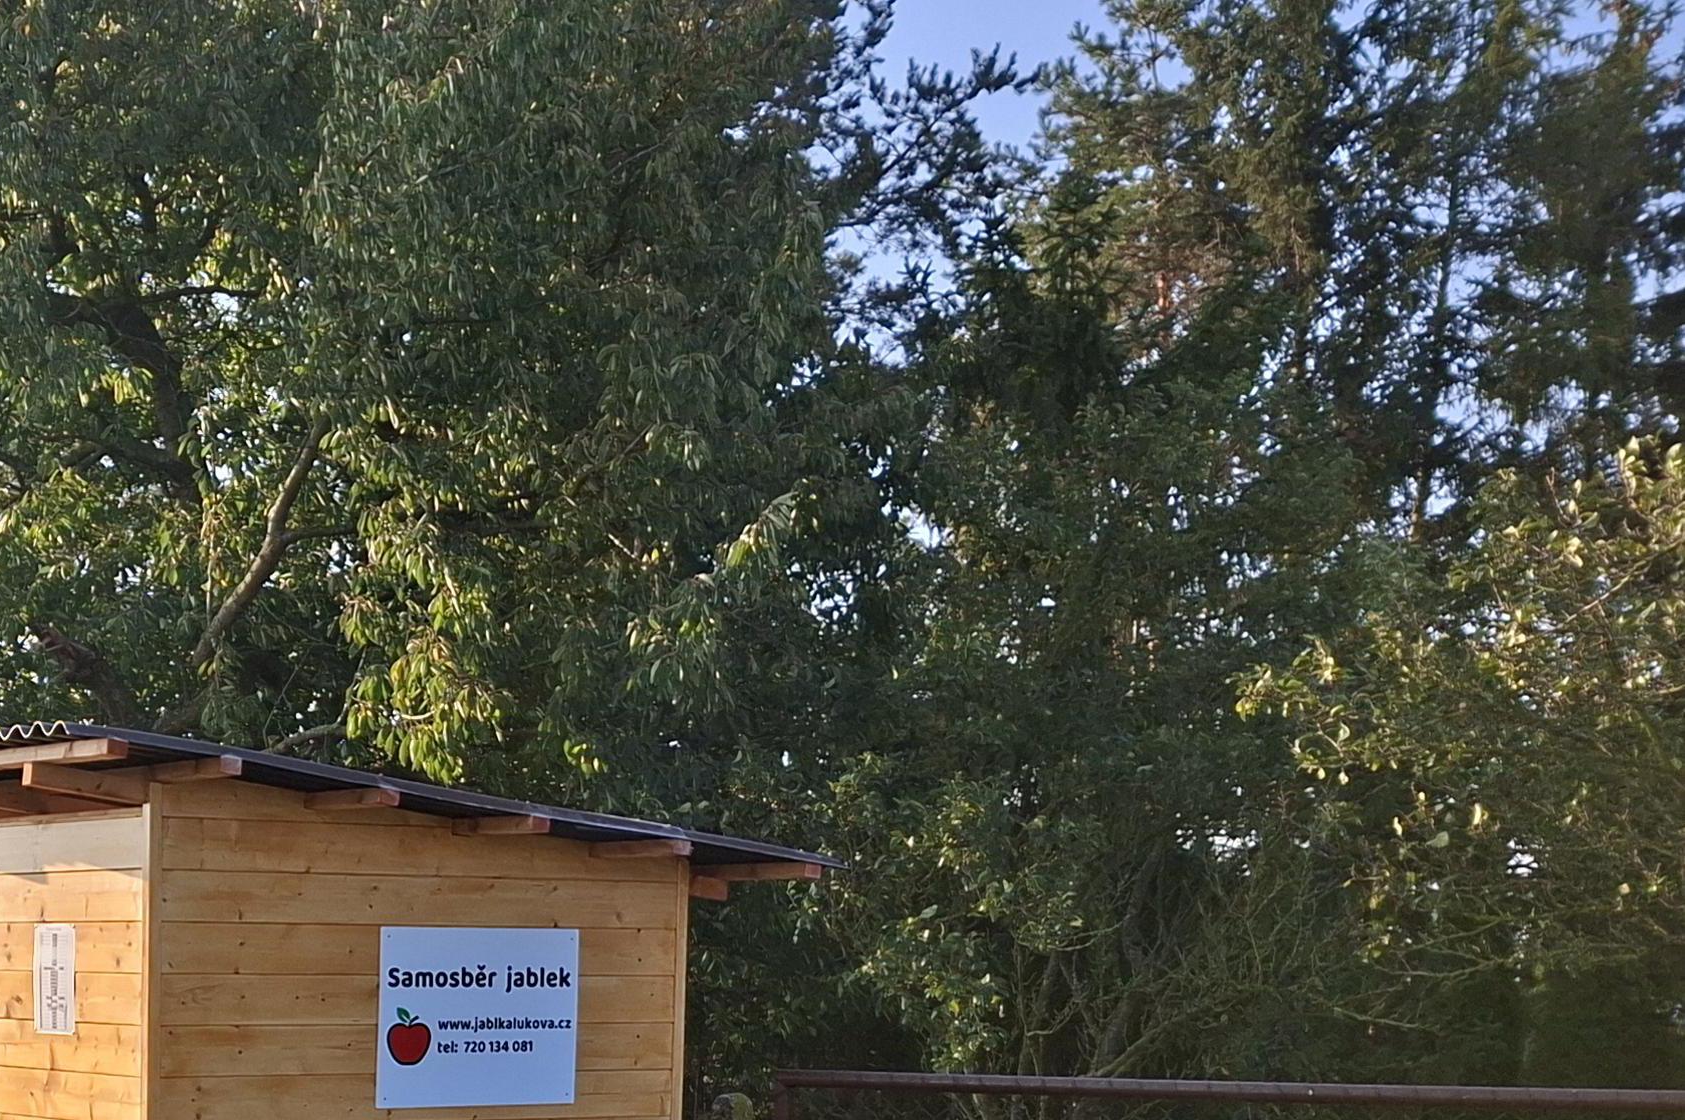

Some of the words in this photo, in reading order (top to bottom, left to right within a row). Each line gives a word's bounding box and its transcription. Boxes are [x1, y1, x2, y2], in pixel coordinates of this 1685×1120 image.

[387, 964, 497, 988] Samosběr
[505, 965, 571, 993] jablek
[437, 1016, 572, 1033] www.jablkalukova.cz
[437, 1041, 458, 1053] tel:
[464, 1041, 486, 1053] 720
[489, 1041, 509, 1052] 134
[512, 1040, 533, 1052] 081
